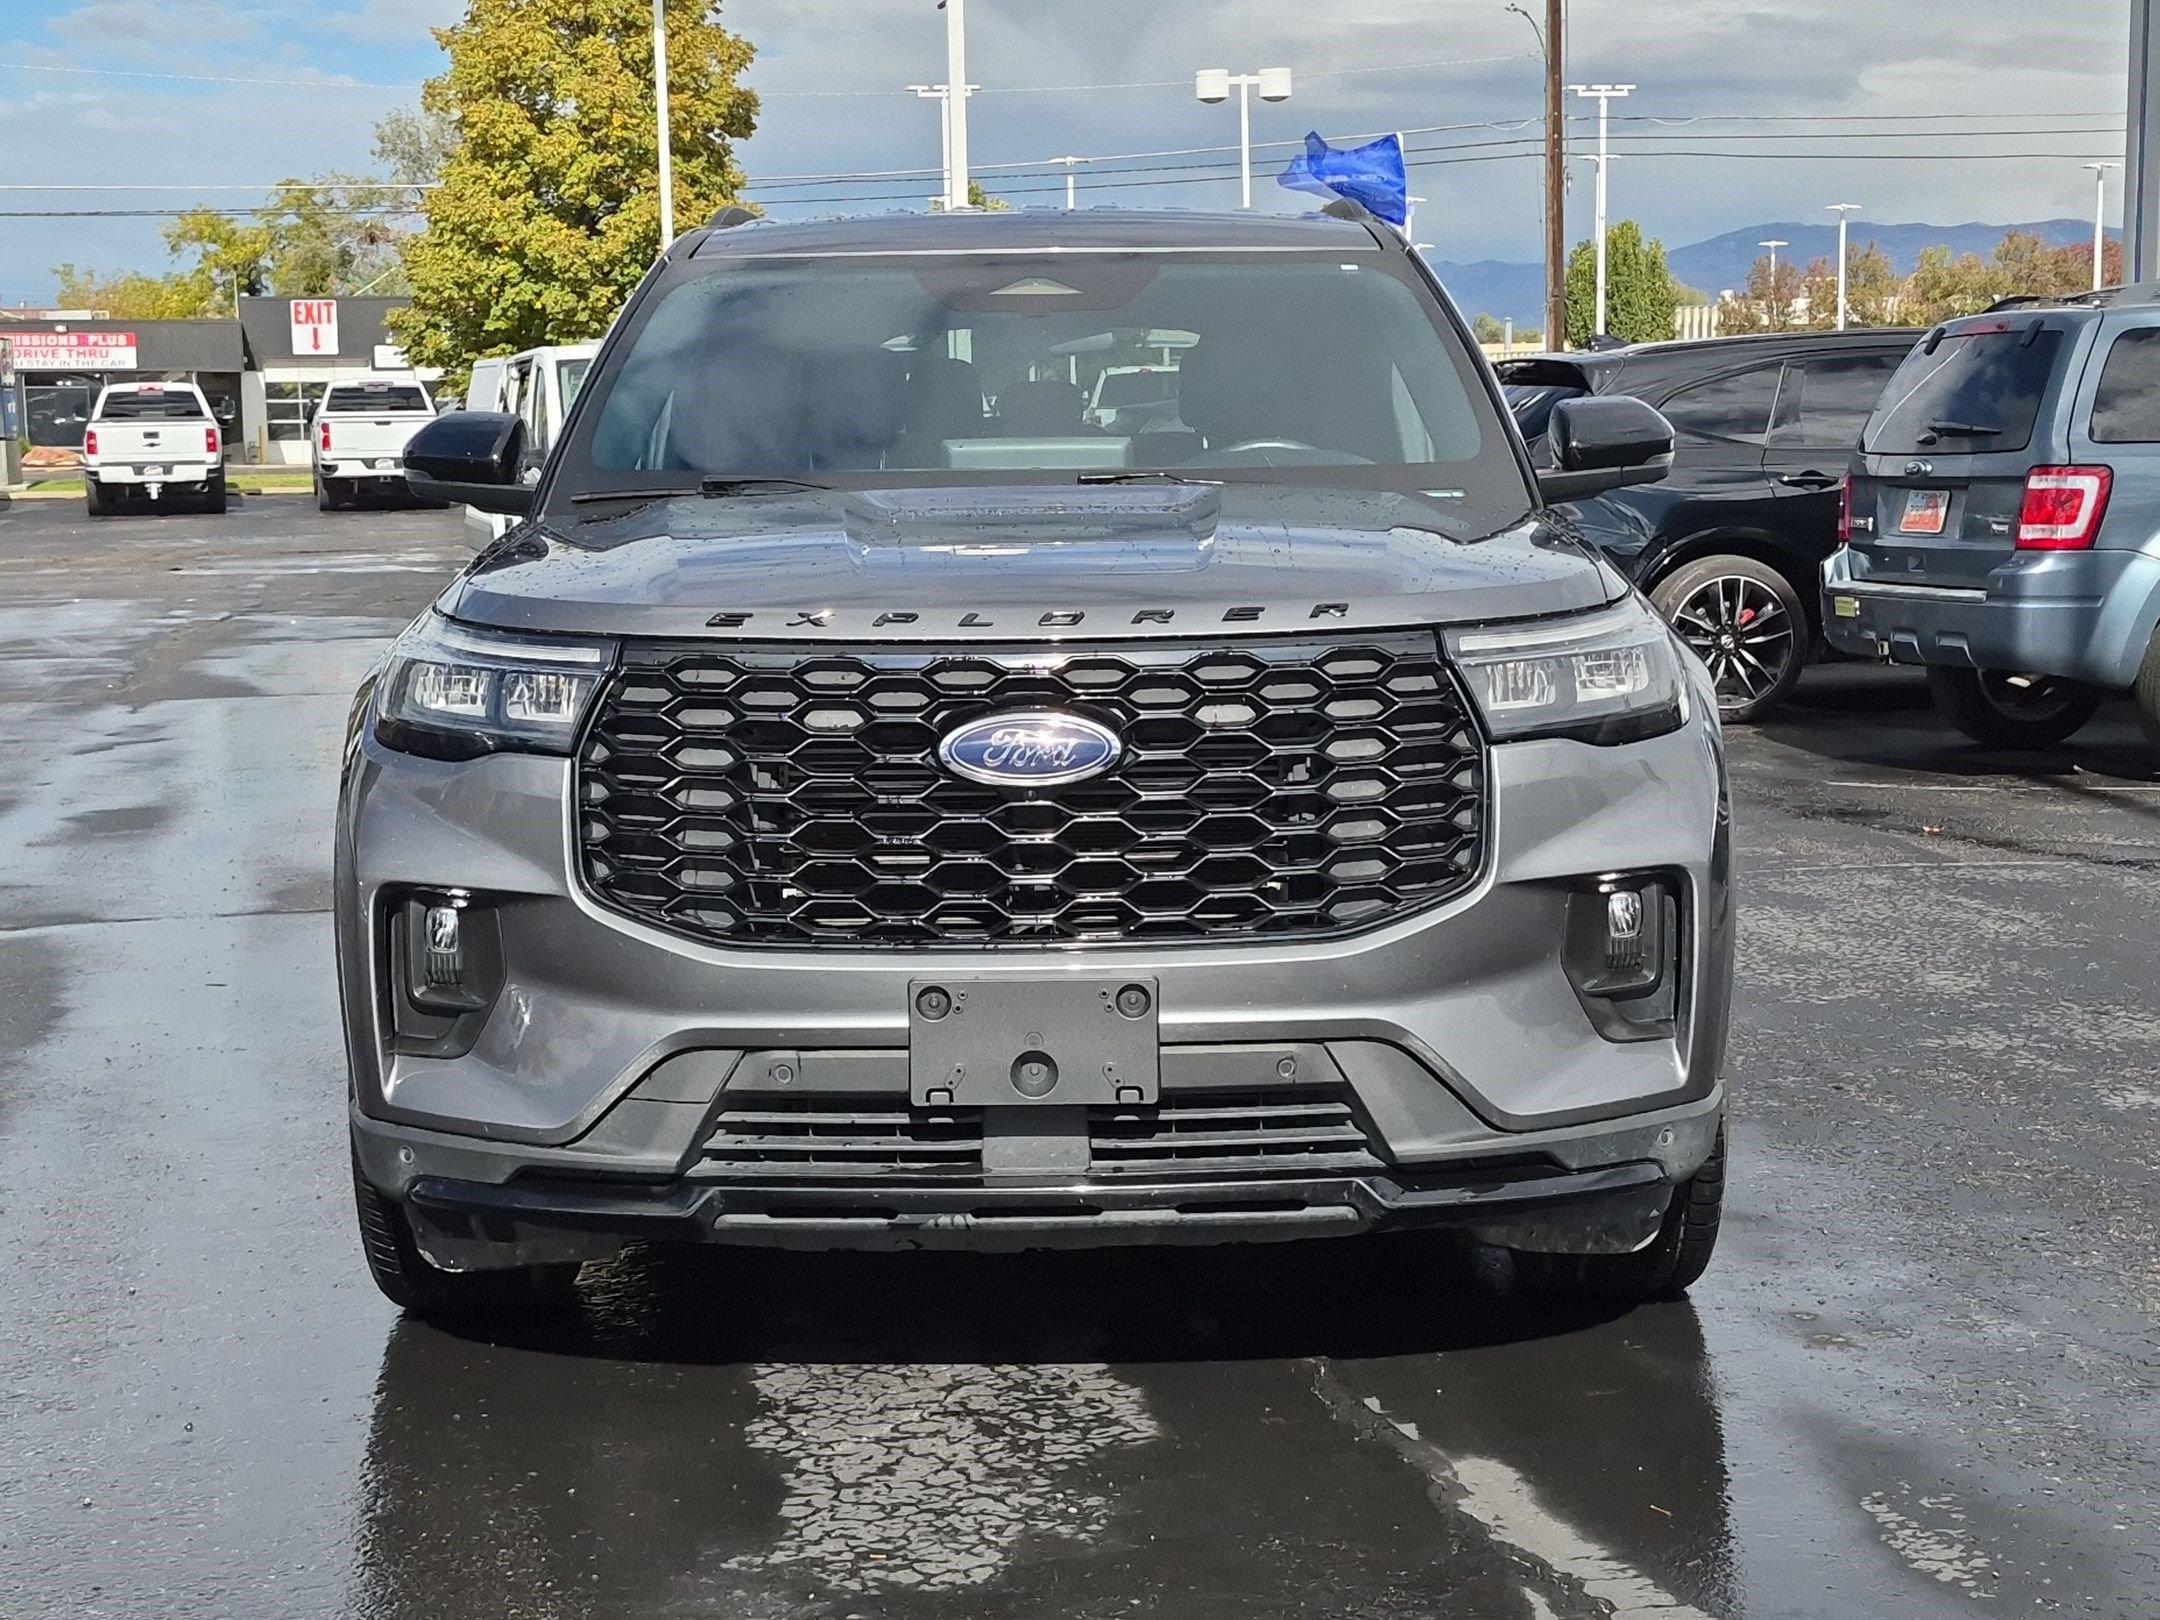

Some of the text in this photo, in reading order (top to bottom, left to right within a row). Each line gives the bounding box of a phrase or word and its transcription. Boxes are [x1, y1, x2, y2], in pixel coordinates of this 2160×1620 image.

[293, 302, 334, 325] EXIT
[13, 334, 128, 347] ISSIONS PLUS
[13, 349, 109, 358] DRIVE THRU
[27, 359, 55, 367] STAY
[60, 359, 71, 367] IN
[75, 359, 95, 367] THE
[101, 359, 126, 367] CAR
[705, 603, 1349, 628] EXPLORER
[983, 728, 1079, 767] Ford
